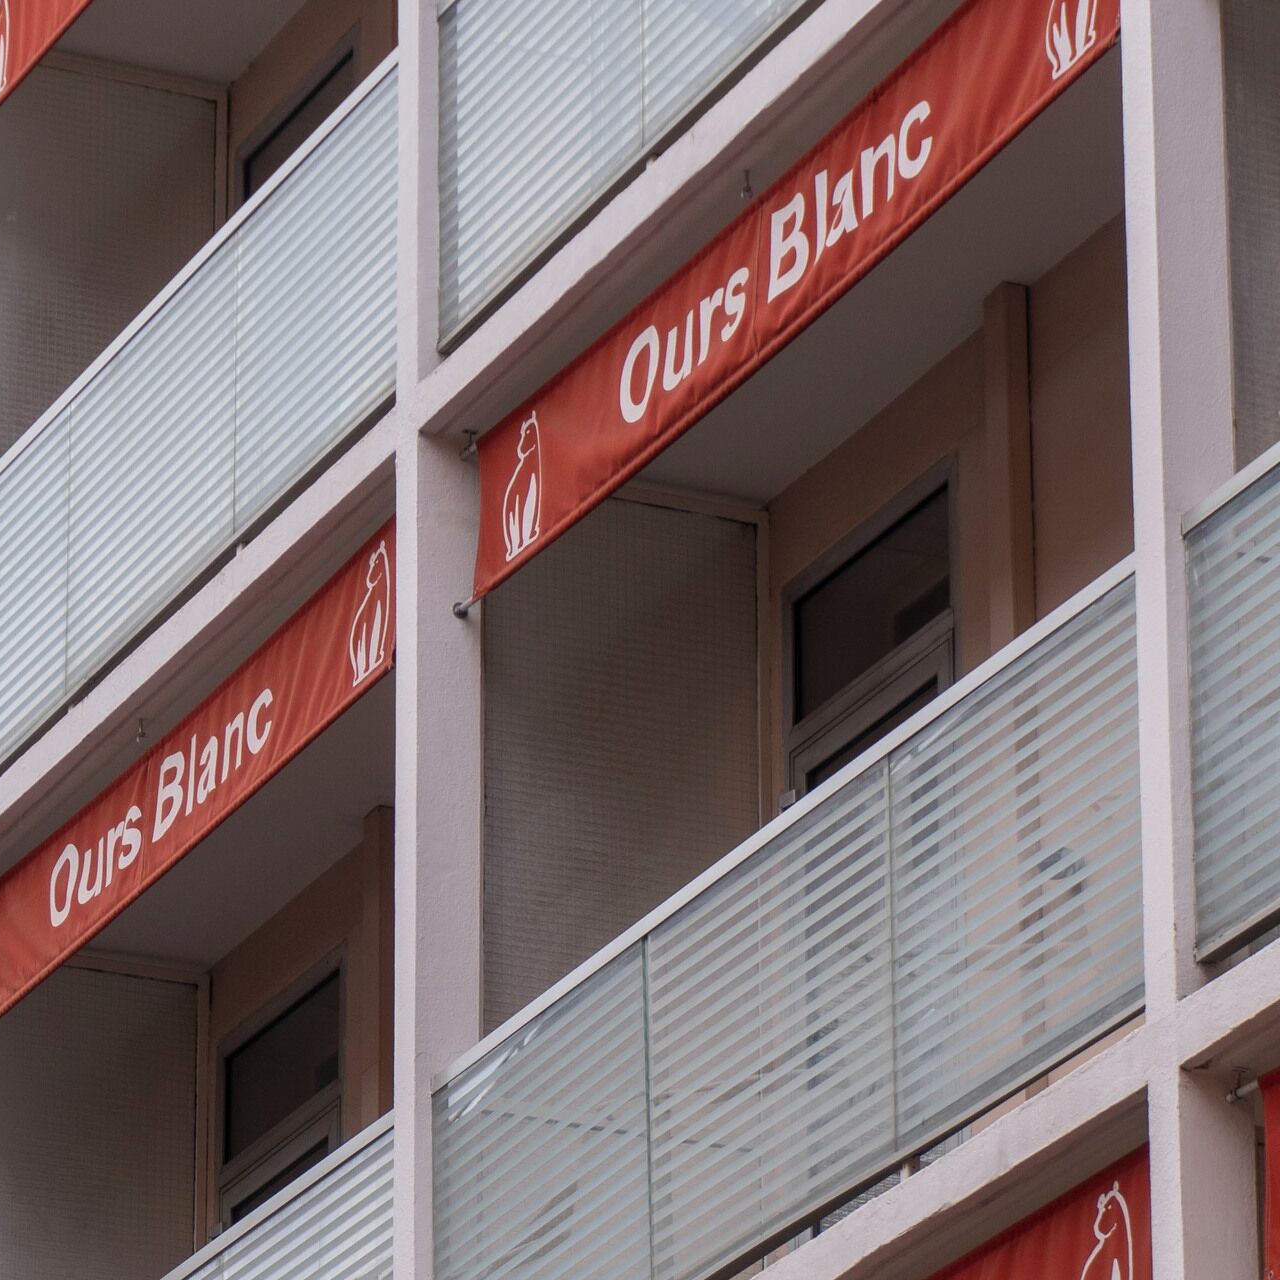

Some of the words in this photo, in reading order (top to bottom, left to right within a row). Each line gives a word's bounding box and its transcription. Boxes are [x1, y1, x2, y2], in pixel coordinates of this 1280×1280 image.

[619, 267, 749, 424] Ours
[767, 100, 933, 303] Blanc
[49, 805, 142, 928] Ours
[151, 688, 273, 843] Blanc
